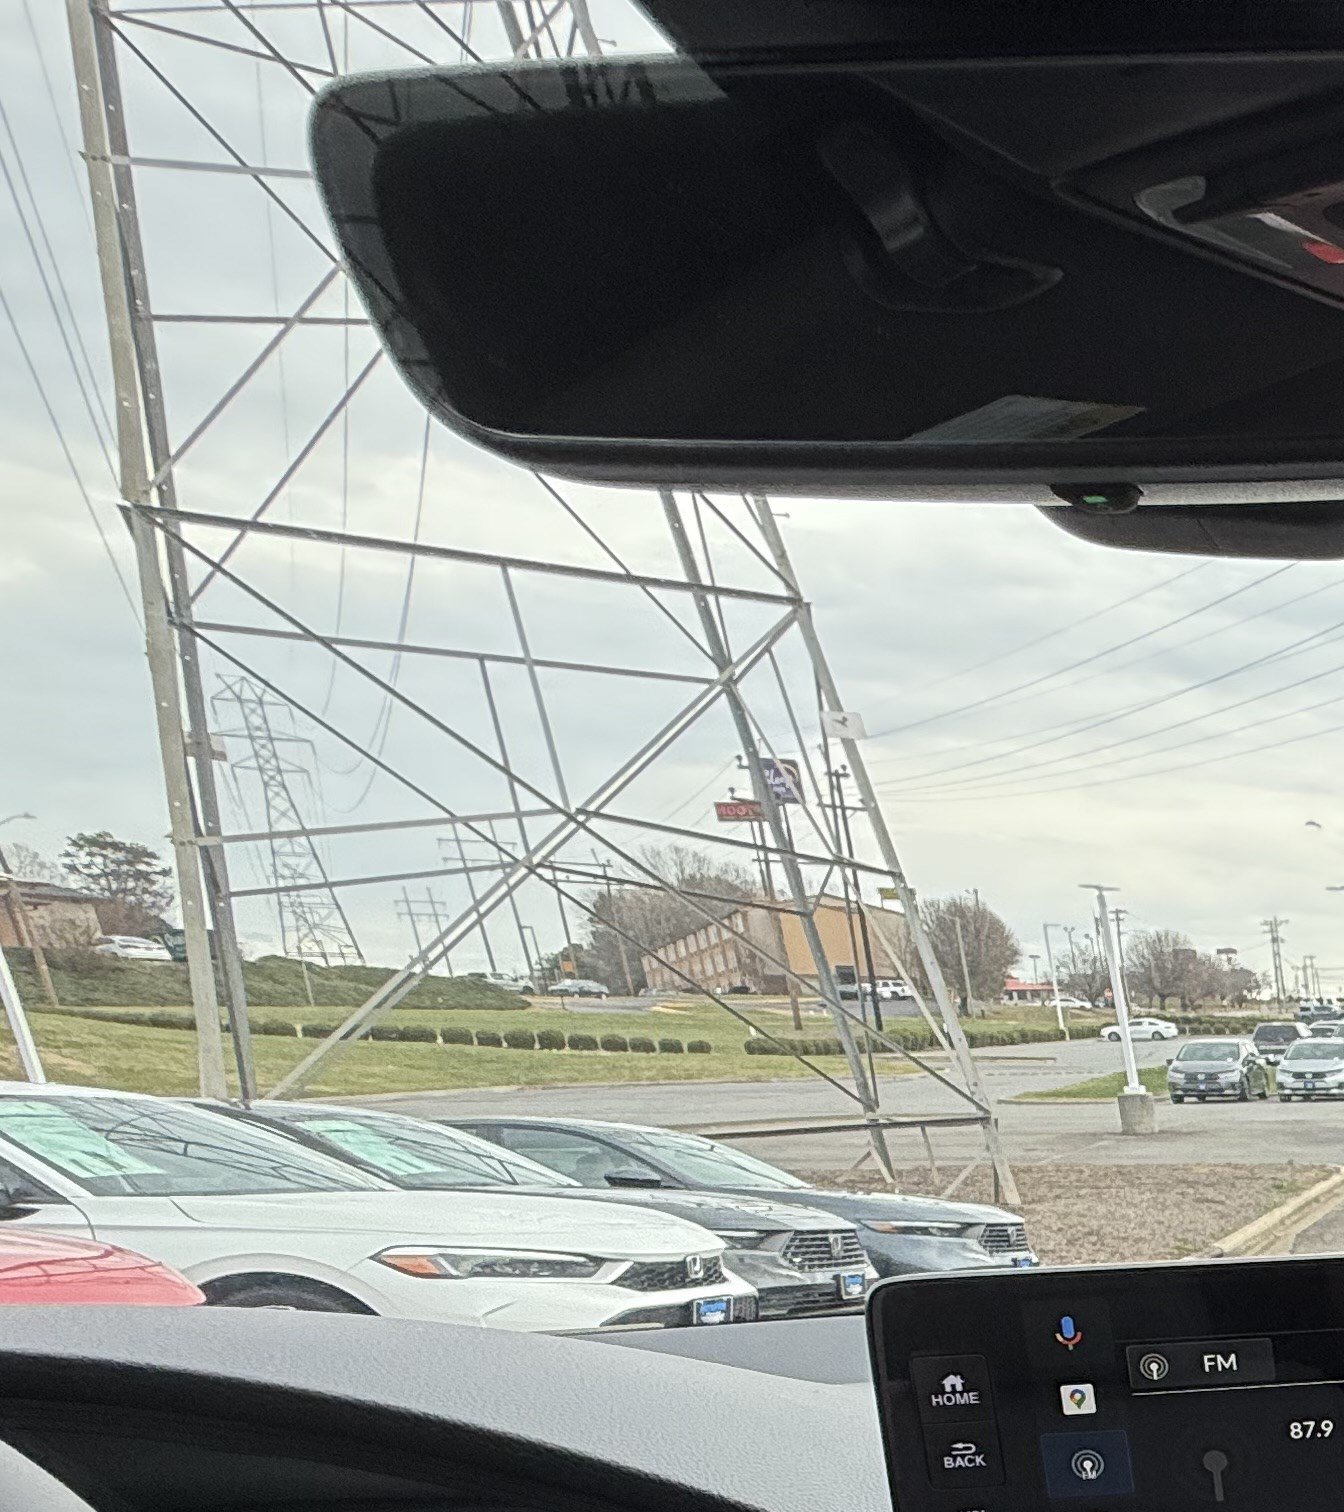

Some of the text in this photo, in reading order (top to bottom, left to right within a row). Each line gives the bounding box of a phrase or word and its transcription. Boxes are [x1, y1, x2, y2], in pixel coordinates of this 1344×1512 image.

[1203, 1354, 1238, 1373] FM
[931, 1390, 980, 1406] HOME
[1289, 1420, 1334, 1440] 87.9
[943, 1453, 987, 1469] BACK
